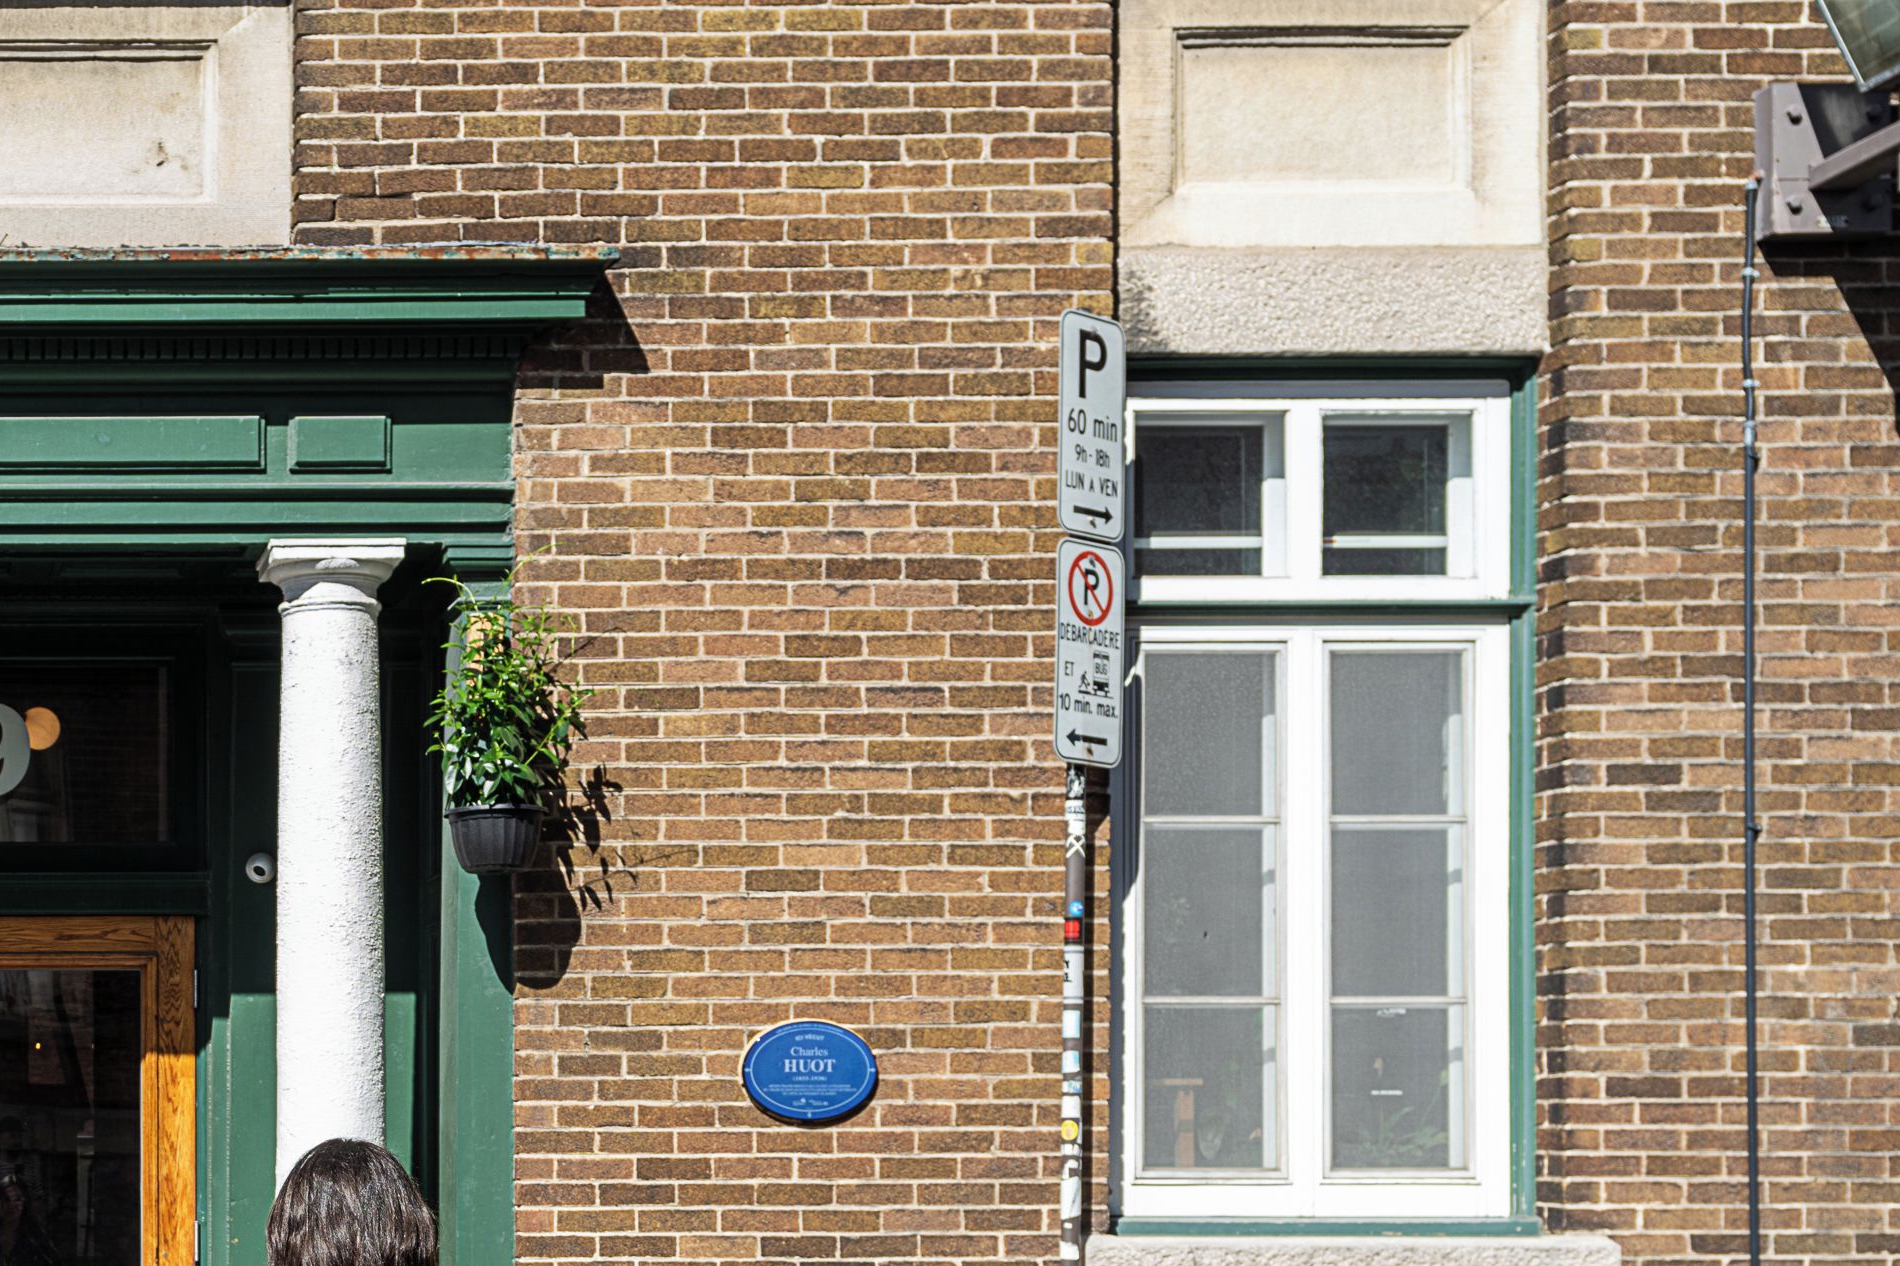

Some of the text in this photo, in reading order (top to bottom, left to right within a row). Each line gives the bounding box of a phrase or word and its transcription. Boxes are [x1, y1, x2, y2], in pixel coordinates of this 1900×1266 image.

[1079, 328, 1107, 399] P
[1068, 408, 1118, 442] 60 min
[1065, 469, 1084, 492] LUN
[1098, 477, 1118, 498] VEN
[1064, 661, 1108, 677] ET BUS
[1060, 693, 1119, 719] 10 min. max.
[790, 1046, 829, 1057] Charles
[784, 1058, 836, 1073] HUOT
